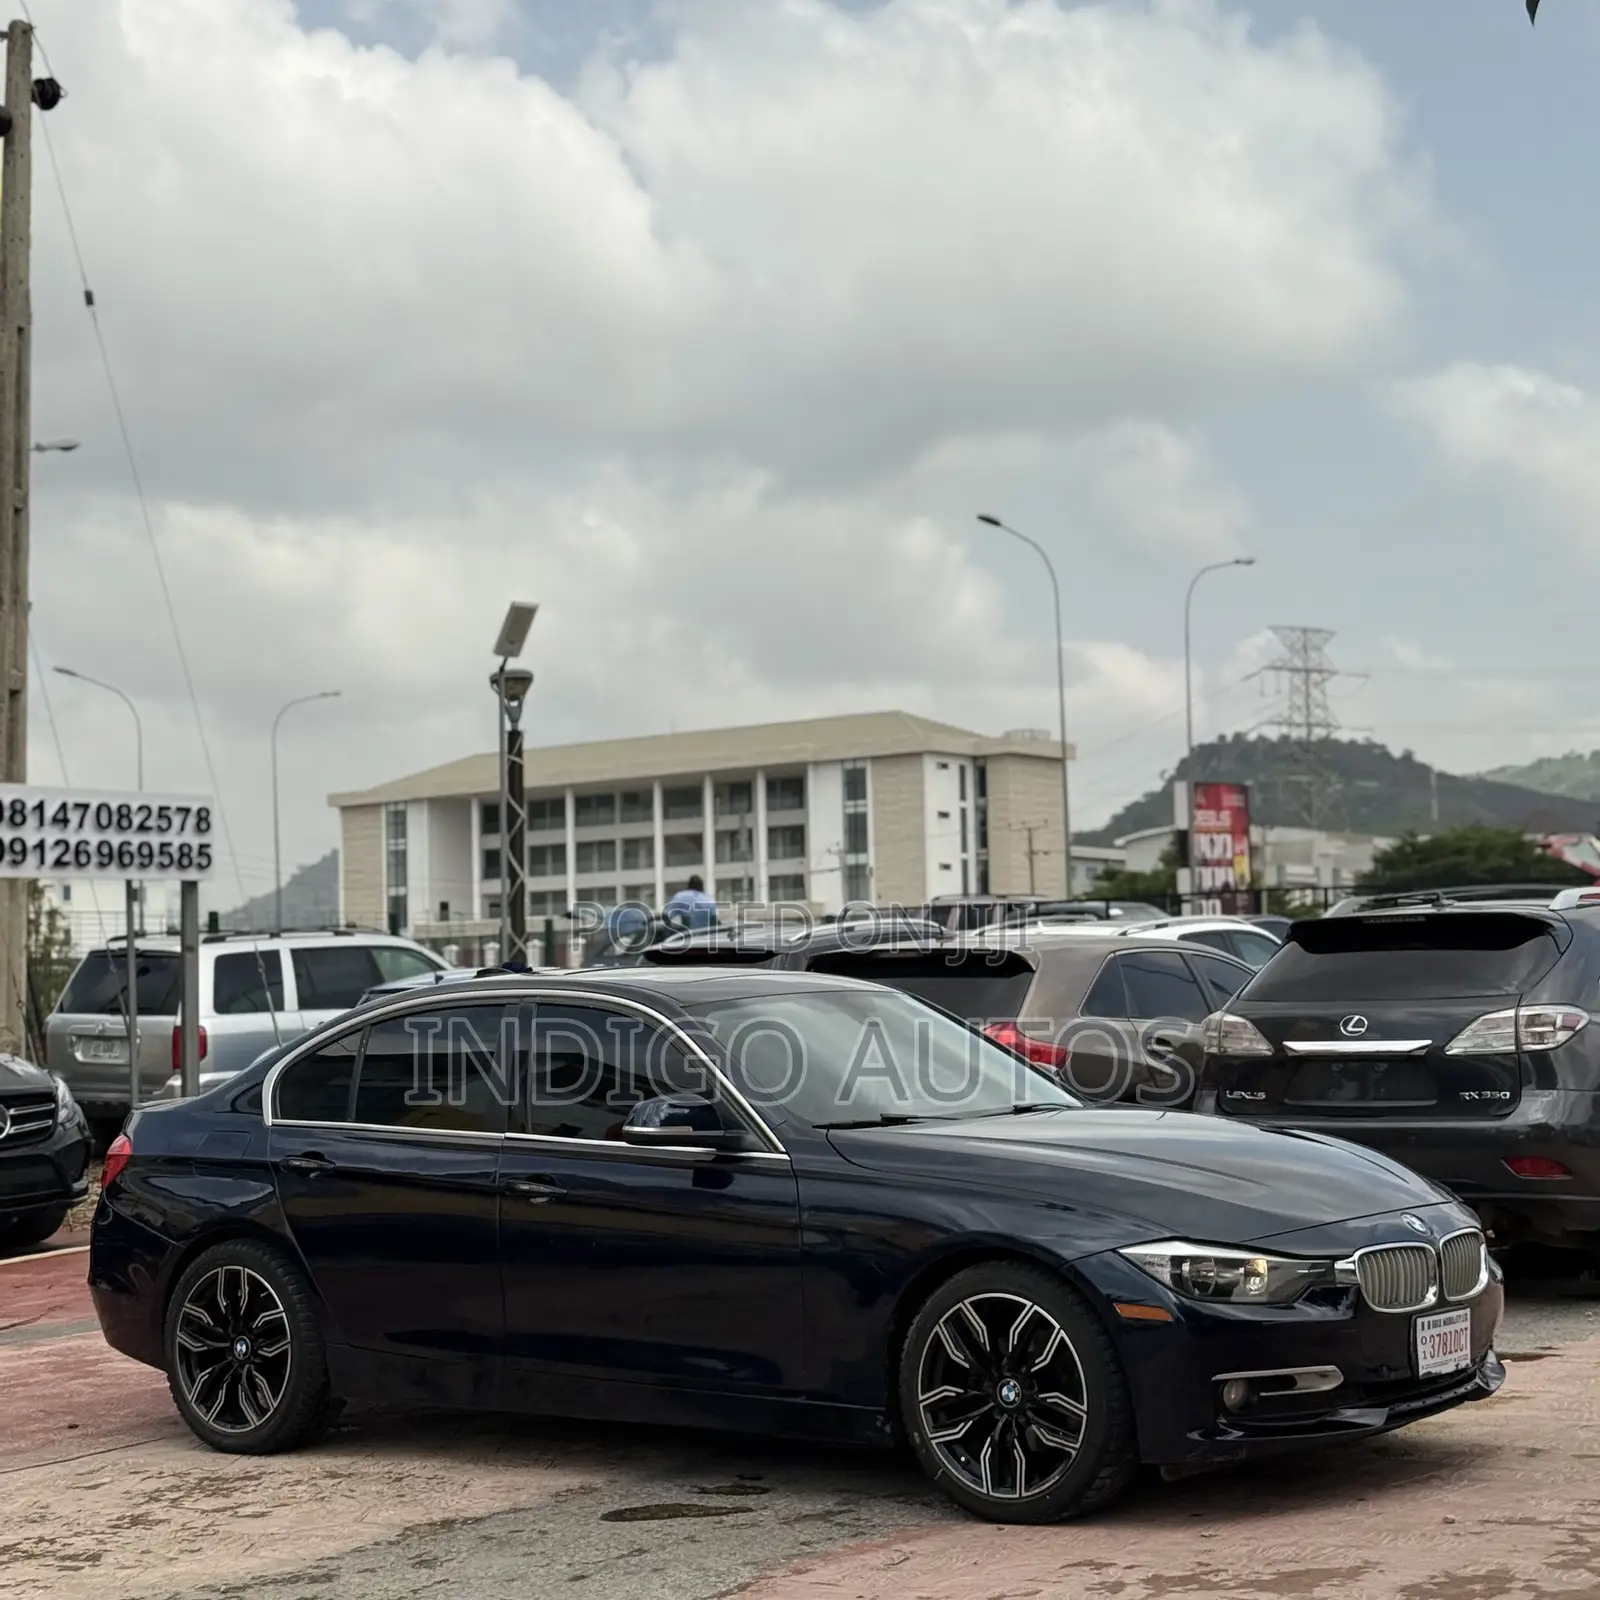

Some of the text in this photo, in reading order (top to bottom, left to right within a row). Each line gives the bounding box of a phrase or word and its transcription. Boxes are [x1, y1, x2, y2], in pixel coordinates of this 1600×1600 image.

[0, 797, 211, 833] 8147082578
[0, 836, 212, 869] 9126969585
[1459, 1090, 1510, 1100] RX 350
